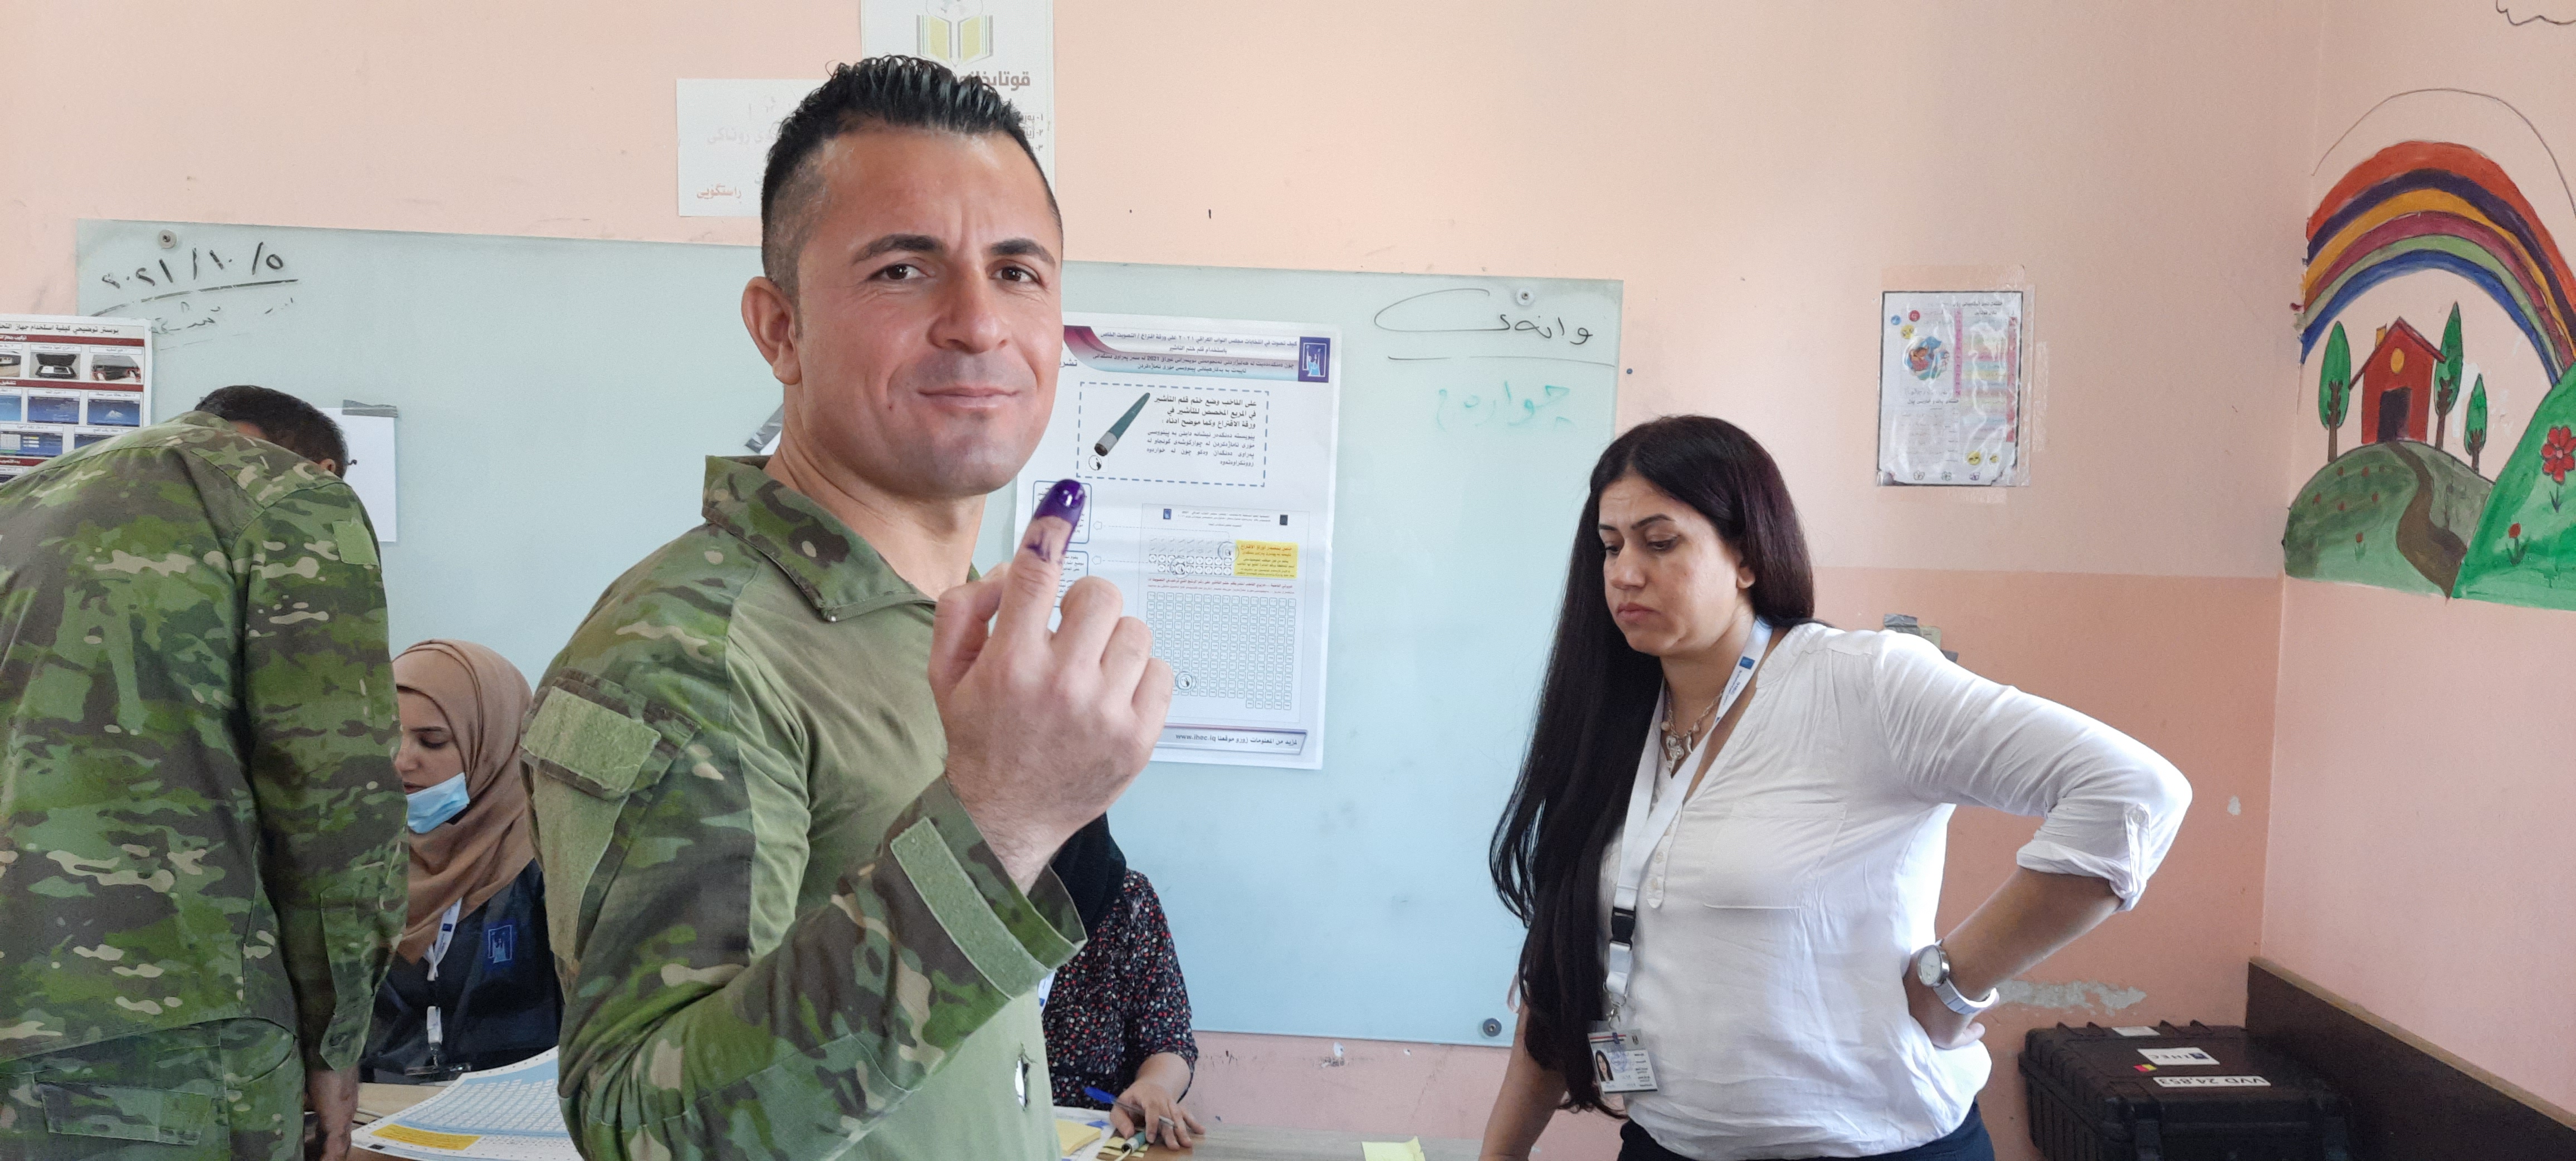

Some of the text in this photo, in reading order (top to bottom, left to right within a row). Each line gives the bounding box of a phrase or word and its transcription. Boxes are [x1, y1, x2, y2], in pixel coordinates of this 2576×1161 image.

[1154, 394, 1176, 403] التأشير
[1178, 396, 1189, 405] قلم
[1191, 397, 1203, 406] ختم
[1205, 398, 1220, 407] وضع
[1167, 406, 1174, 417] في
[1230, 409, 1247, 419] المربع
[1248, 410, 1256, 420] في
[1181, 418, 1201, 427] موضح
[1202, 418, 1216, 427] وكما
[1217, 419, 1240, 429] الاقتراع
[1242, 421, 1256, 430] ورقة
